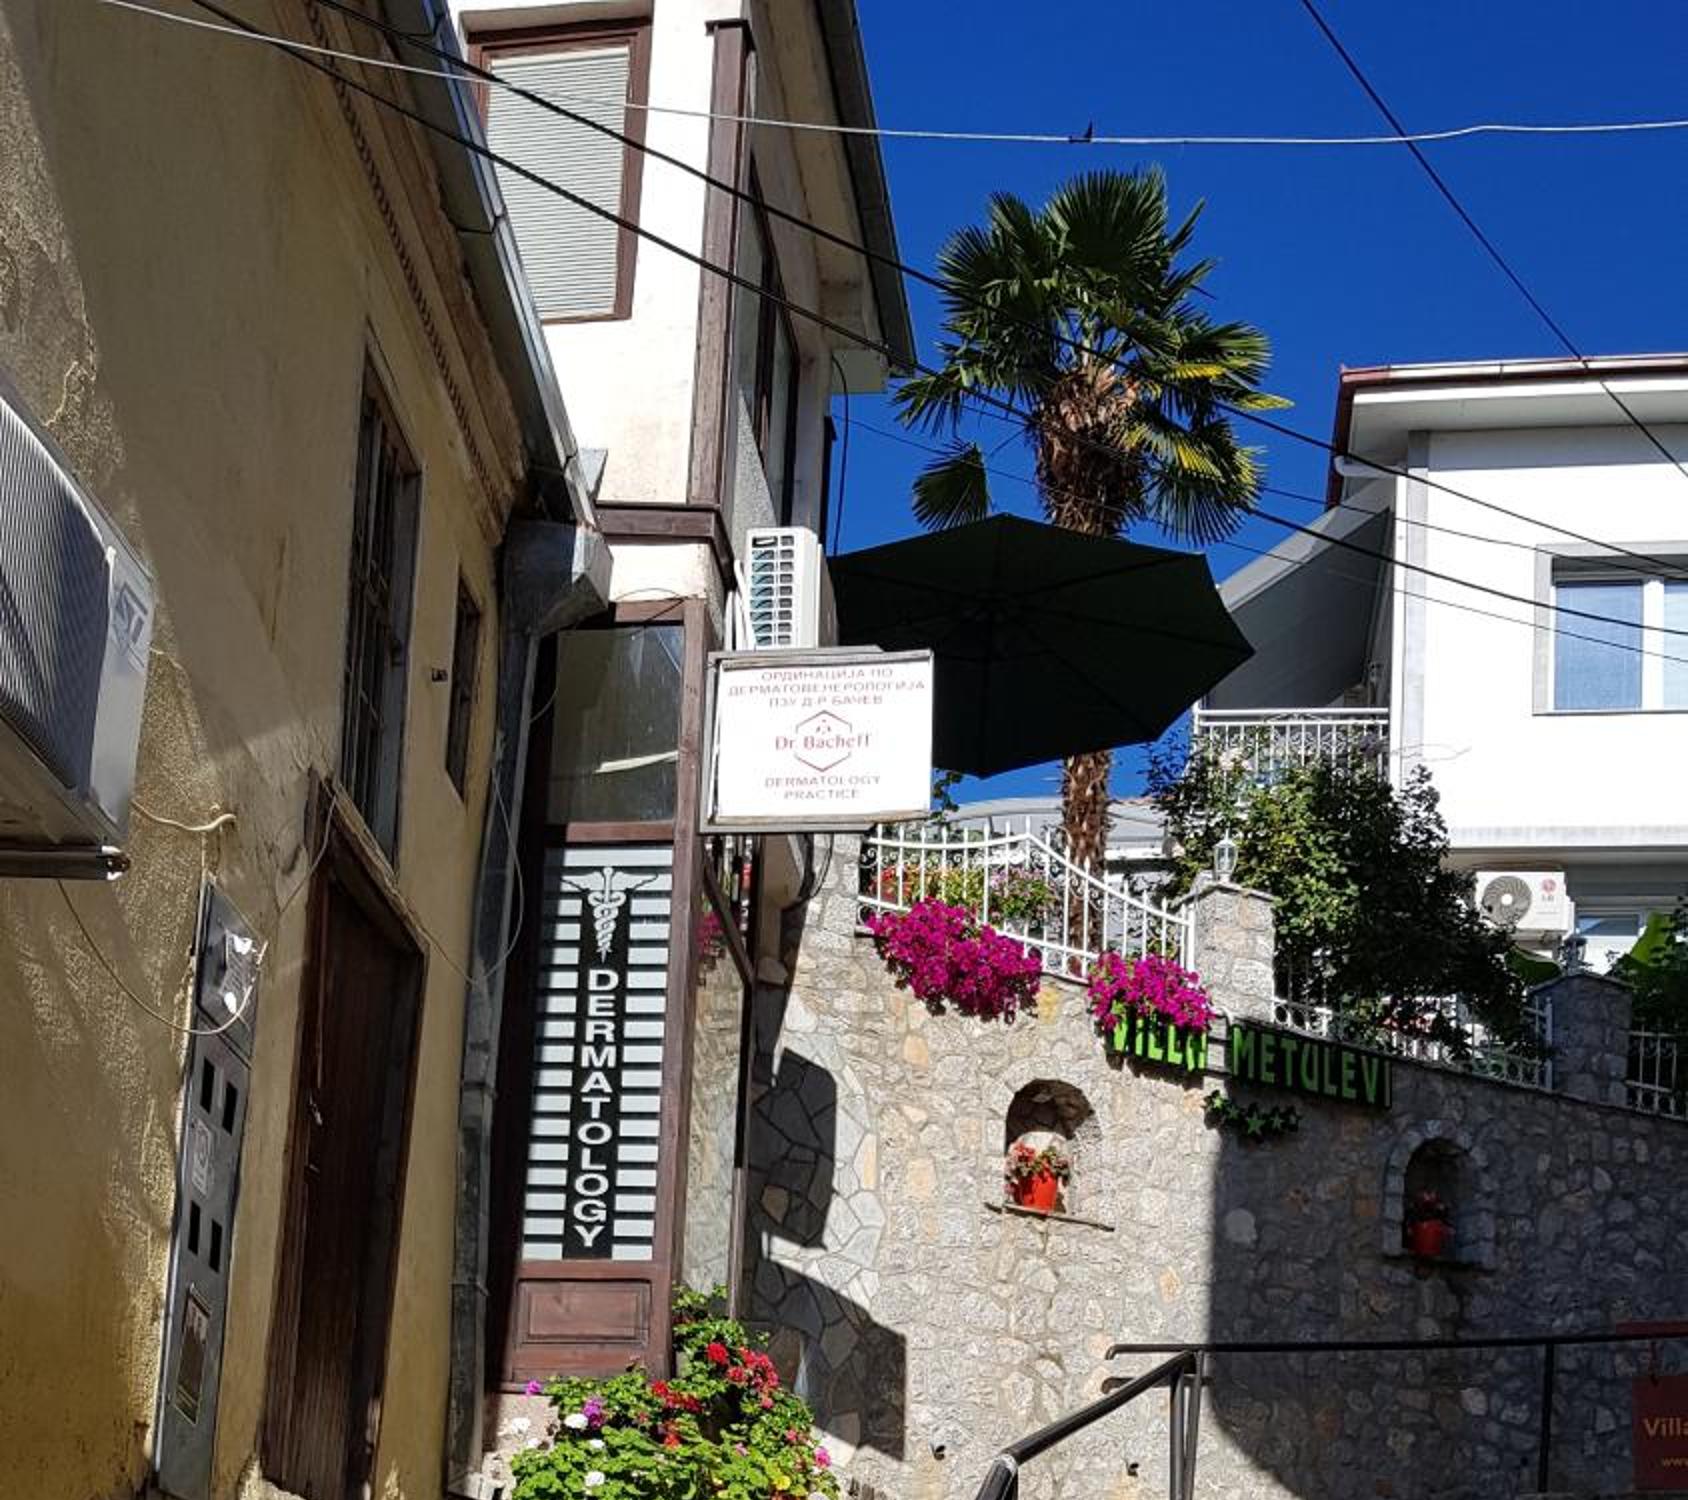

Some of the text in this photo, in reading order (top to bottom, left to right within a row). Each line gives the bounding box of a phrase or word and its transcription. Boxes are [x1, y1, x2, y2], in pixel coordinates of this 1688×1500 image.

[761, 668, 893, 682] ОРДИНАЦИЈА ПО
[803, 733, 870, 750] Bacheff
[764, 775, 881, 788] DERMATOLOGY
[783, 788, 859, 800] PRACTICE
[573, 969, 619, 1247] DERMATOLOGY
